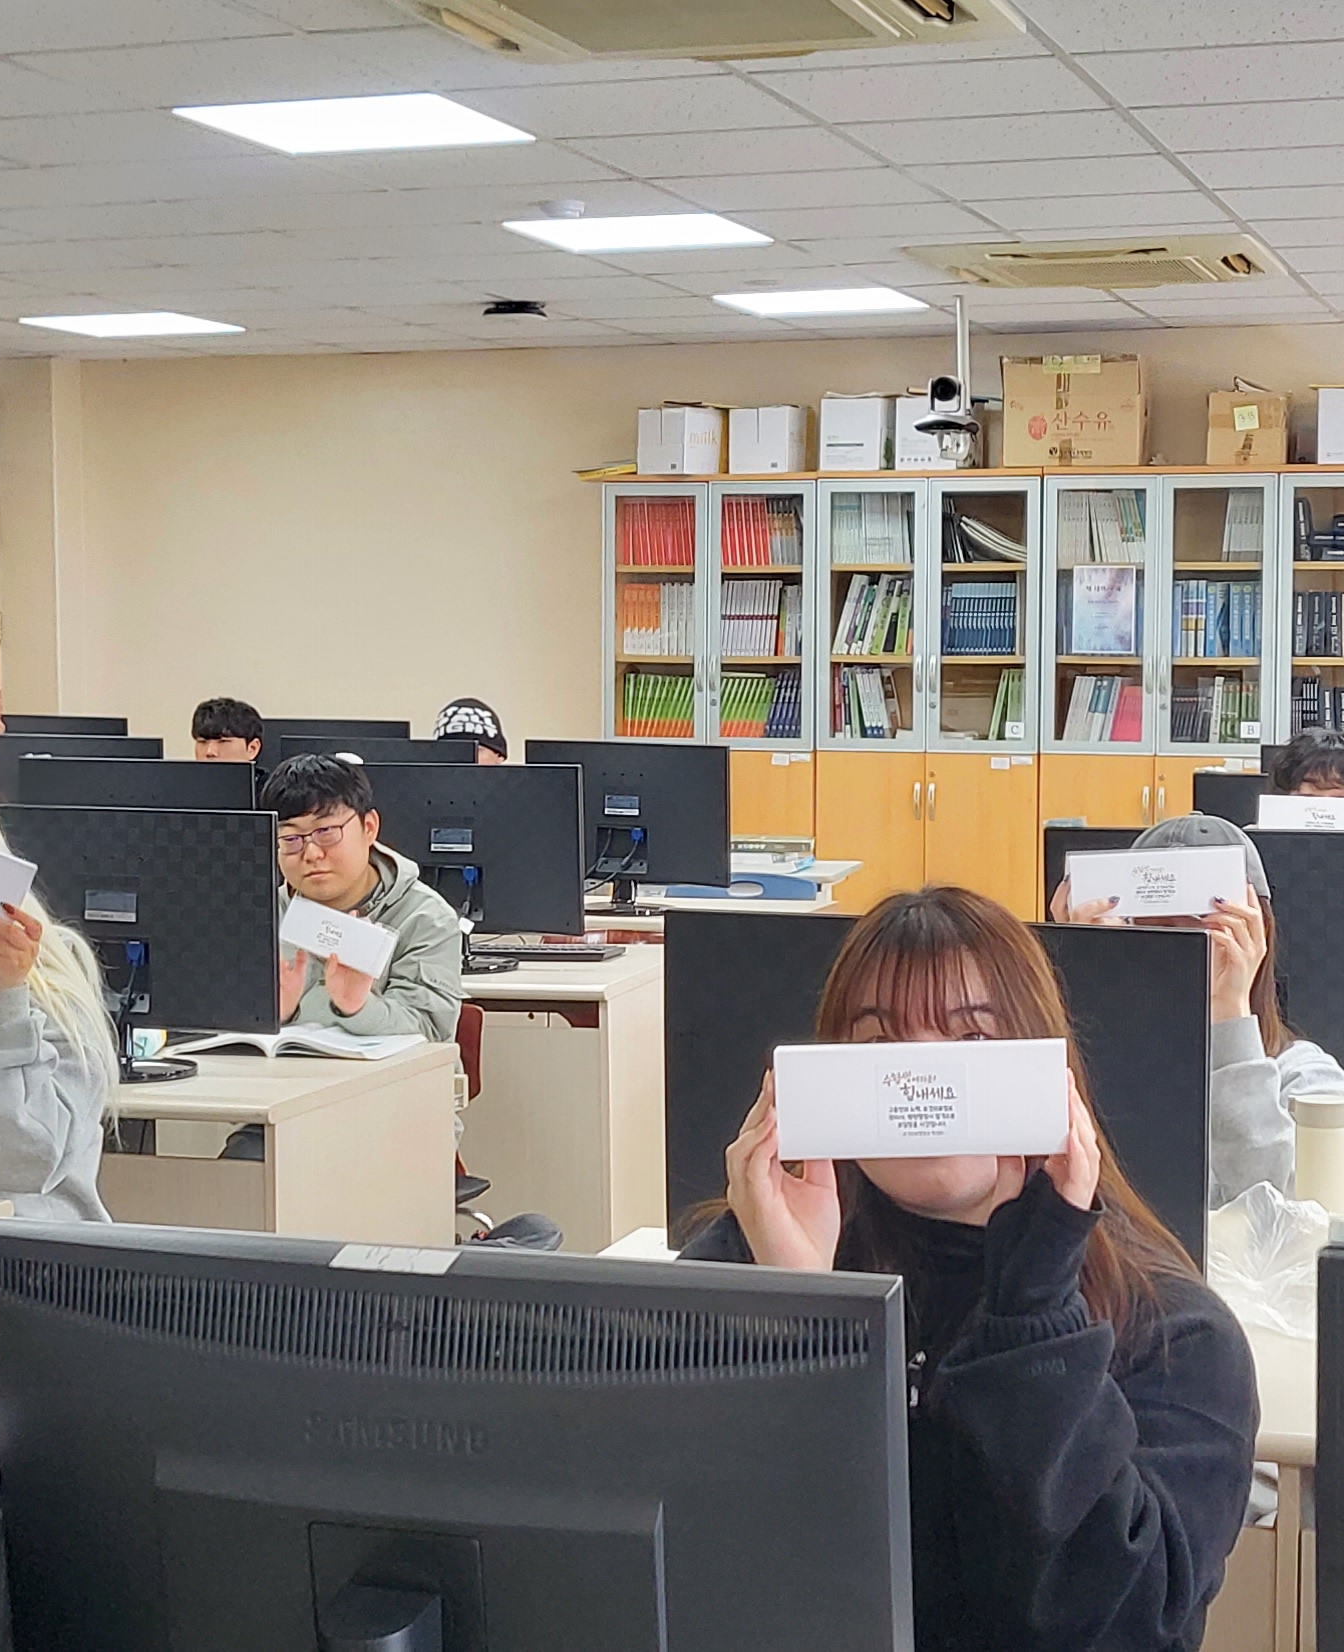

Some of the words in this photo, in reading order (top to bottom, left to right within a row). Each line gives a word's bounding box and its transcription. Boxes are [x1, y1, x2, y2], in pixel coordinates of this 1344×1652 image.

[1051, 410, 1112, 432] 산수유
[1010, 724, 1020, 736] C
[1246, 724, 1256, 735] B
[899, 1083, 957, 1101] 힘내세요
